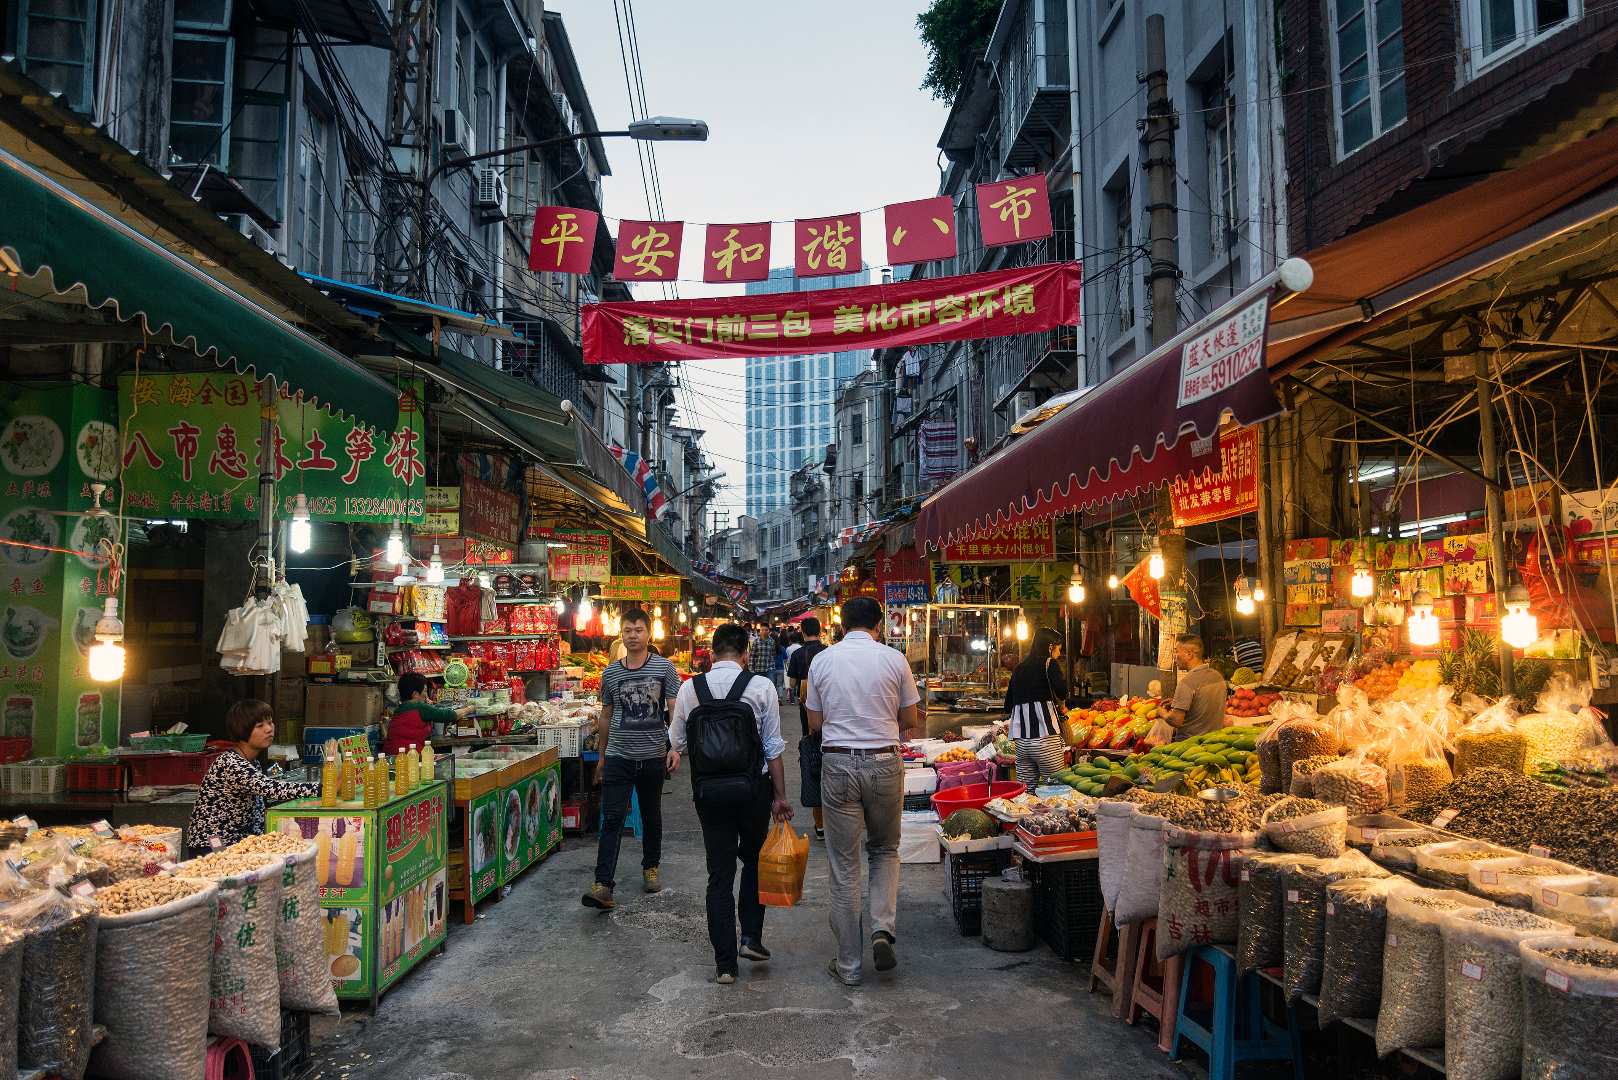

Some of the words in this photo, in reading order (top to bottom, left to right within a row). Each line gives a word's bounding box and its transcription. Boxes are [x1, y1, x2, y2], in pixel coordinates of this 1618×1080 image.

[622, 310, 812, 347] 落实门前三包
[832, 283, 1037, 336] 美化市容环境
